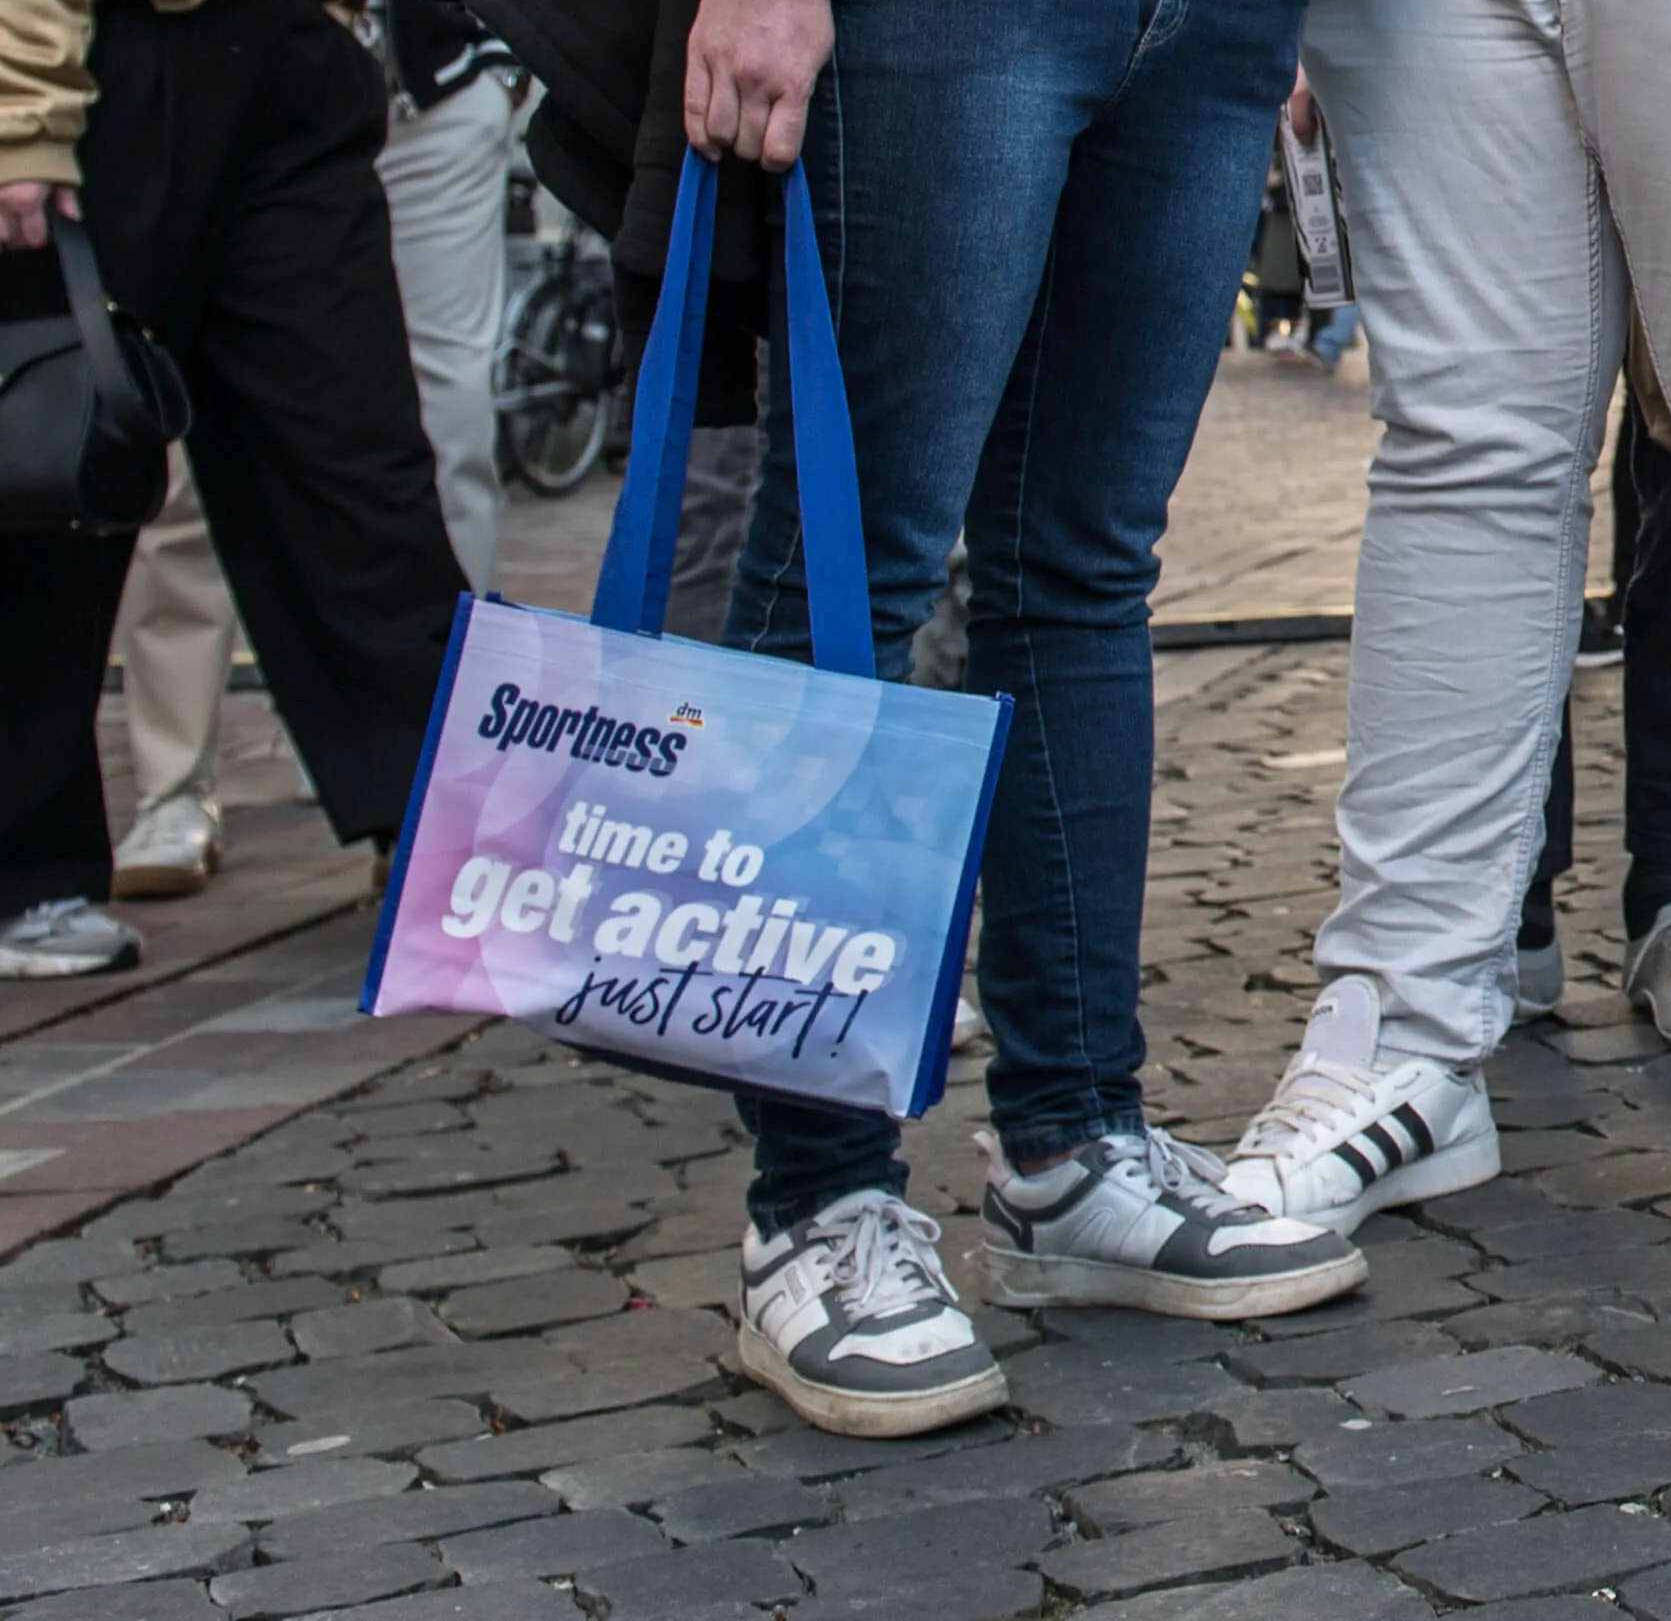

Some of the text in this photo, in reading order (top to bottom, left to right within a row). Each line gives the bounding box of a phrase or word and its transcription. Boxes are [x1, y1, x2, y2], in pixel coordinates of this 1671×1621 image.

[478, 683, 687, 777] Sportness
[676, 701, 702, 719] dm
[558, 801, 764, 887] time to
[441, 856, 896, 996] get active
[555, 956, 713, 1037] just
